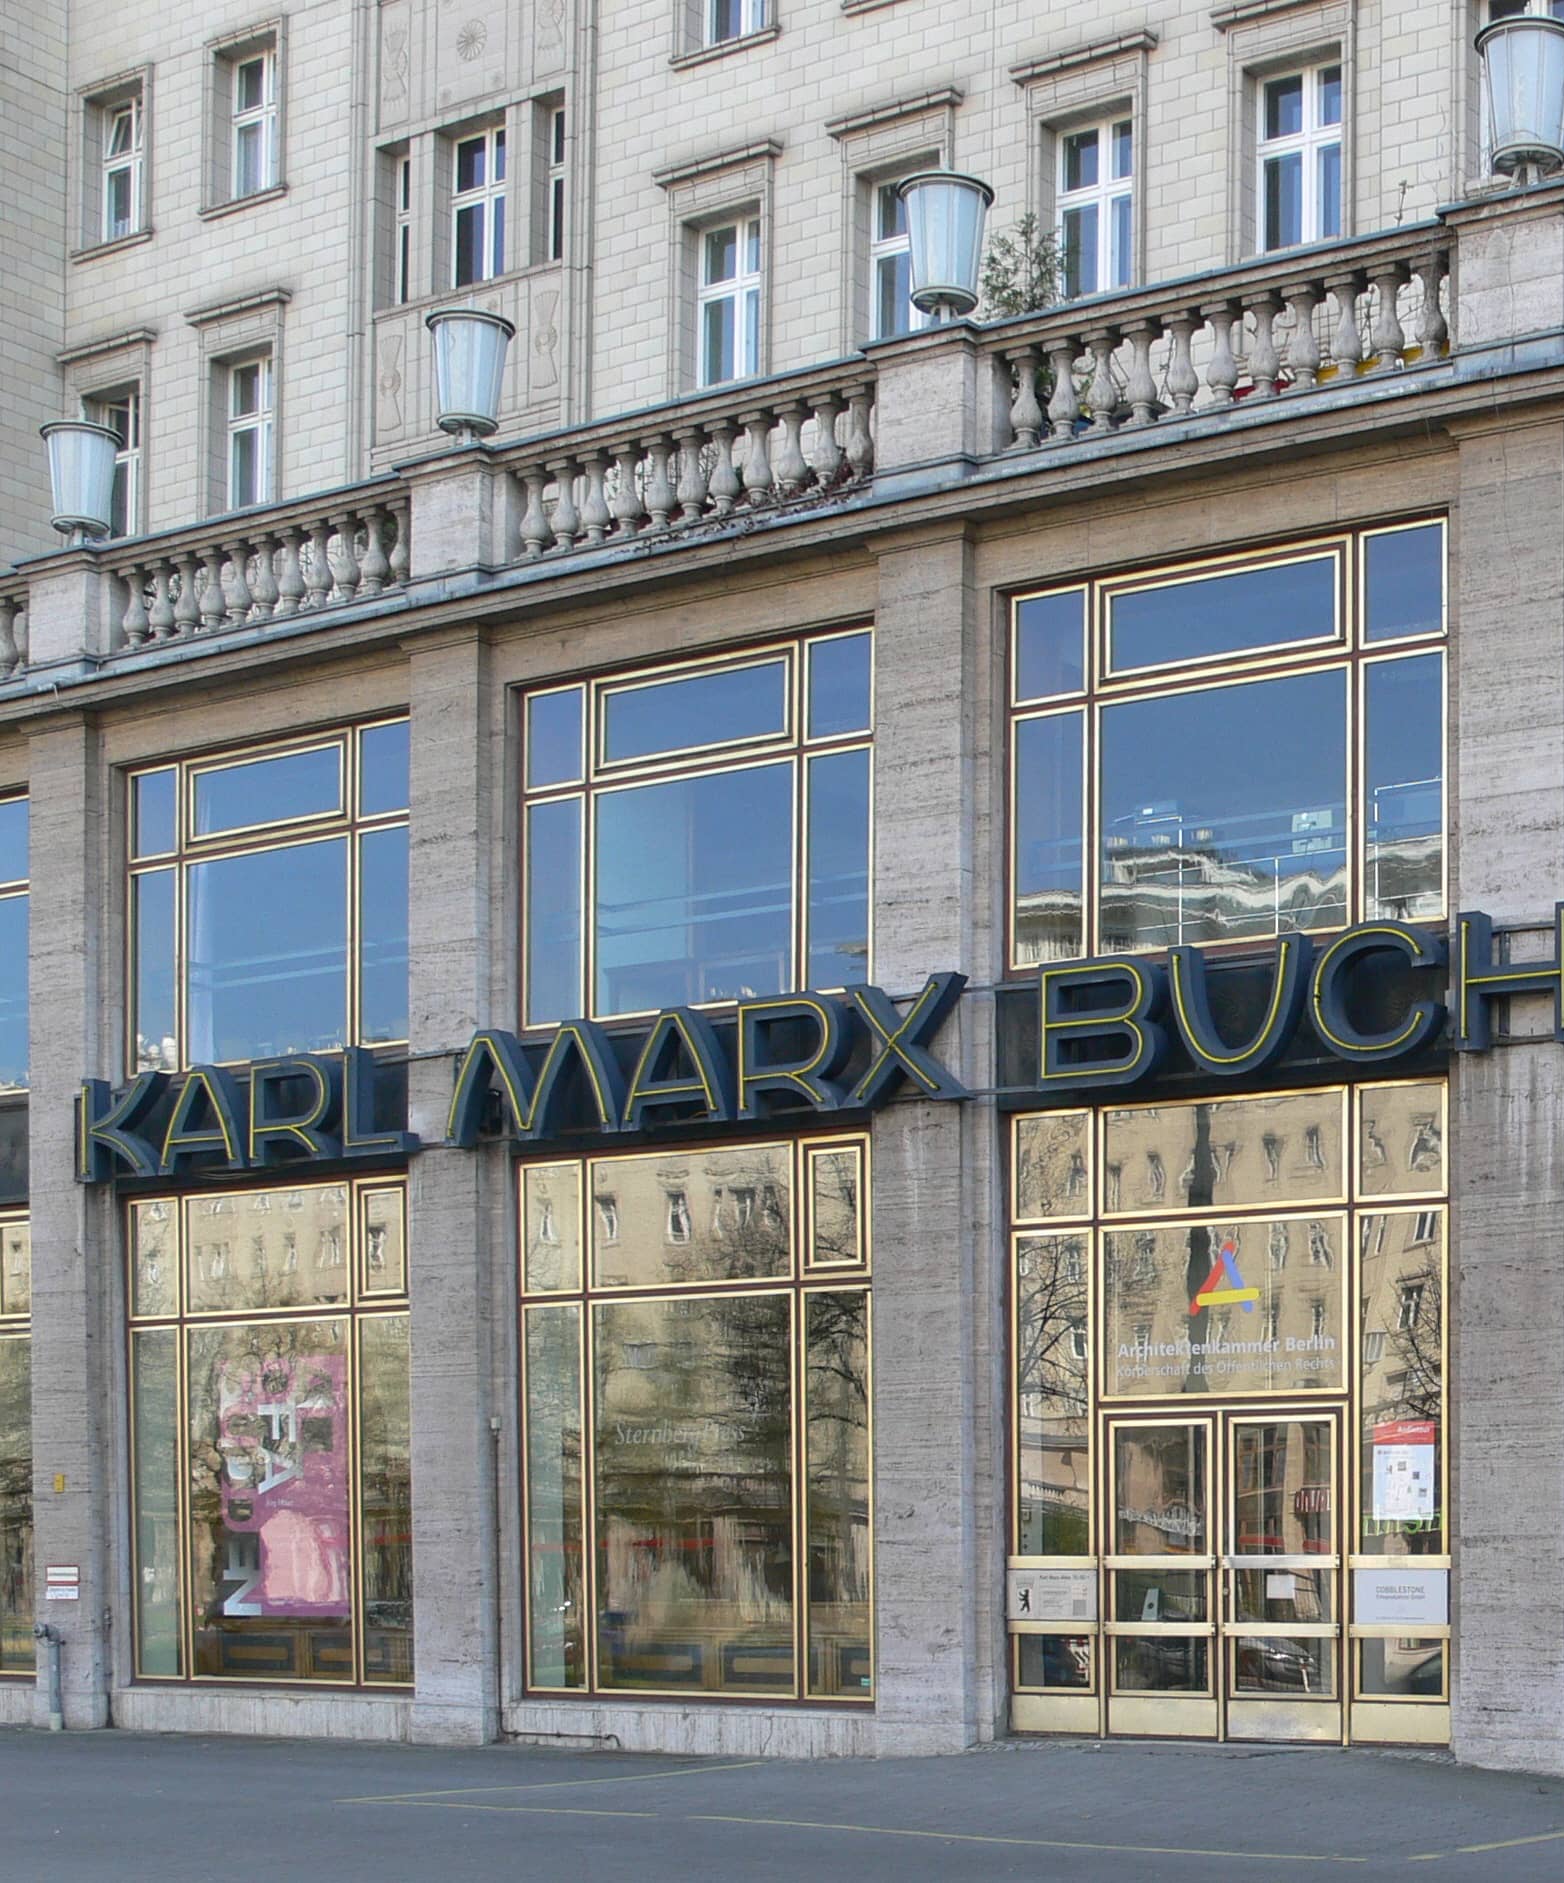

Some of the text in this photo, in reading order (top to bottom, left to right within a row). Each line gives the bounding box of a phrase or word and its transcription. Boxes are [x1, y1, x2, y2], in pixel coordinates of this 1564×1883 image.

[75, 1046, 420, 1184] KARL
[445, 972, 976, 1148] MARX
[1118, 1336, 1335, 1359] Architektenkammer Berlin
